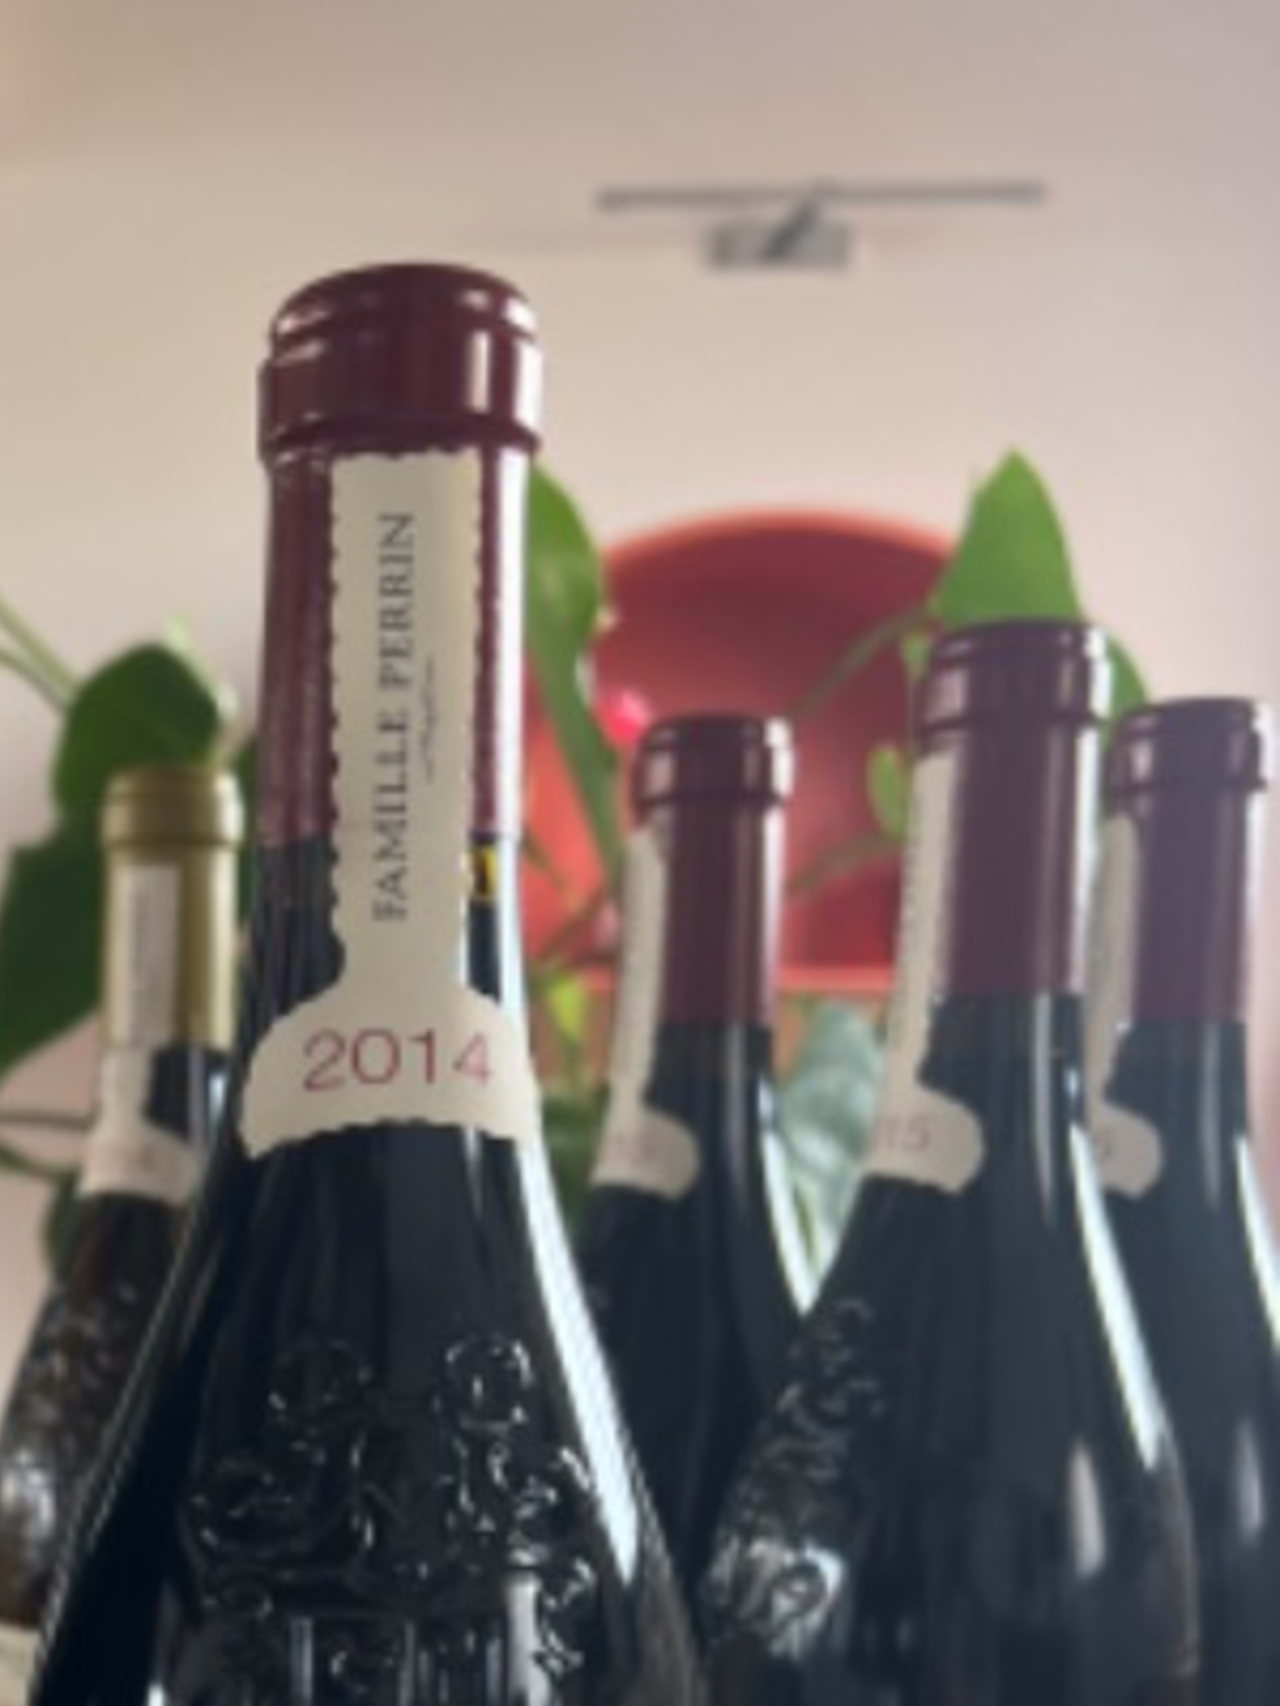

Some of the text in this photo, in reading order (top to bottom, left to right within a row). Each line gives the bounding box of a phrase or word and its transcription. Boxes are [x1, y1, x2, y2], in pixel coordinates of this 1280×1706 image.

[373, 513, 416, 922] FAMILLE PERRIN
[302, 1028, 494, 1092] 2014
